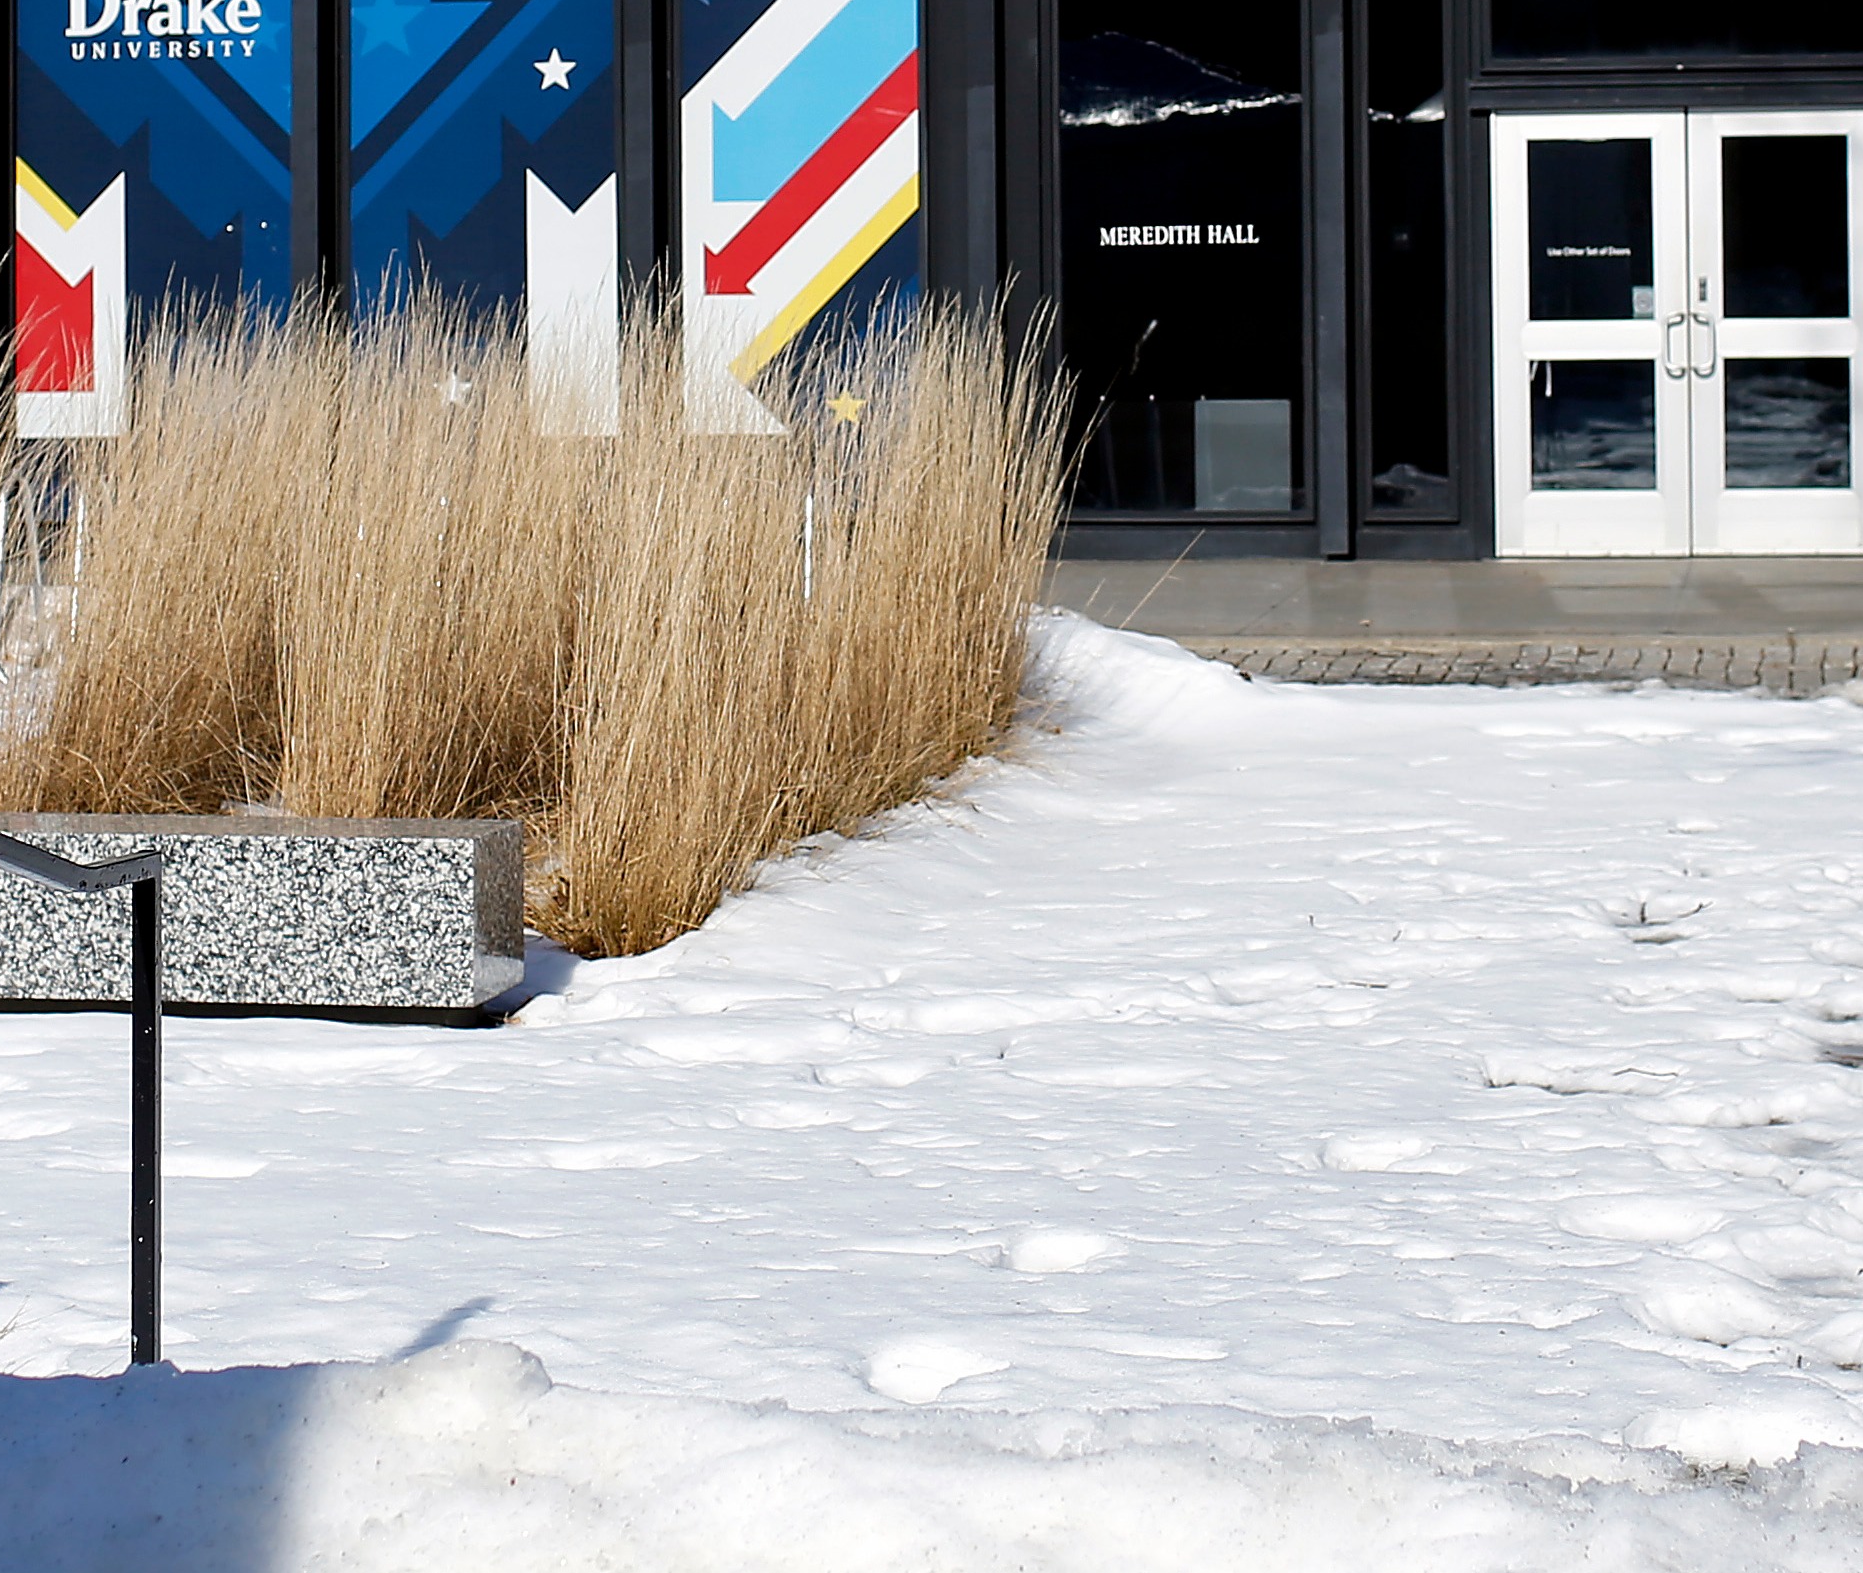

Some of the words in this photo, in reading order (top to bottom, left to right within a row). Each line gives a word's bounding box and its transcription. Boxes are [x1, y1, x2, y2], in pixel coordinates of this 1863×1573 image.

[71, 39, 256, 61] UNIVERSITY
[1099, 224, 1201, 246] MEREDITH
[1207, 223, 1260, 244] HALL
